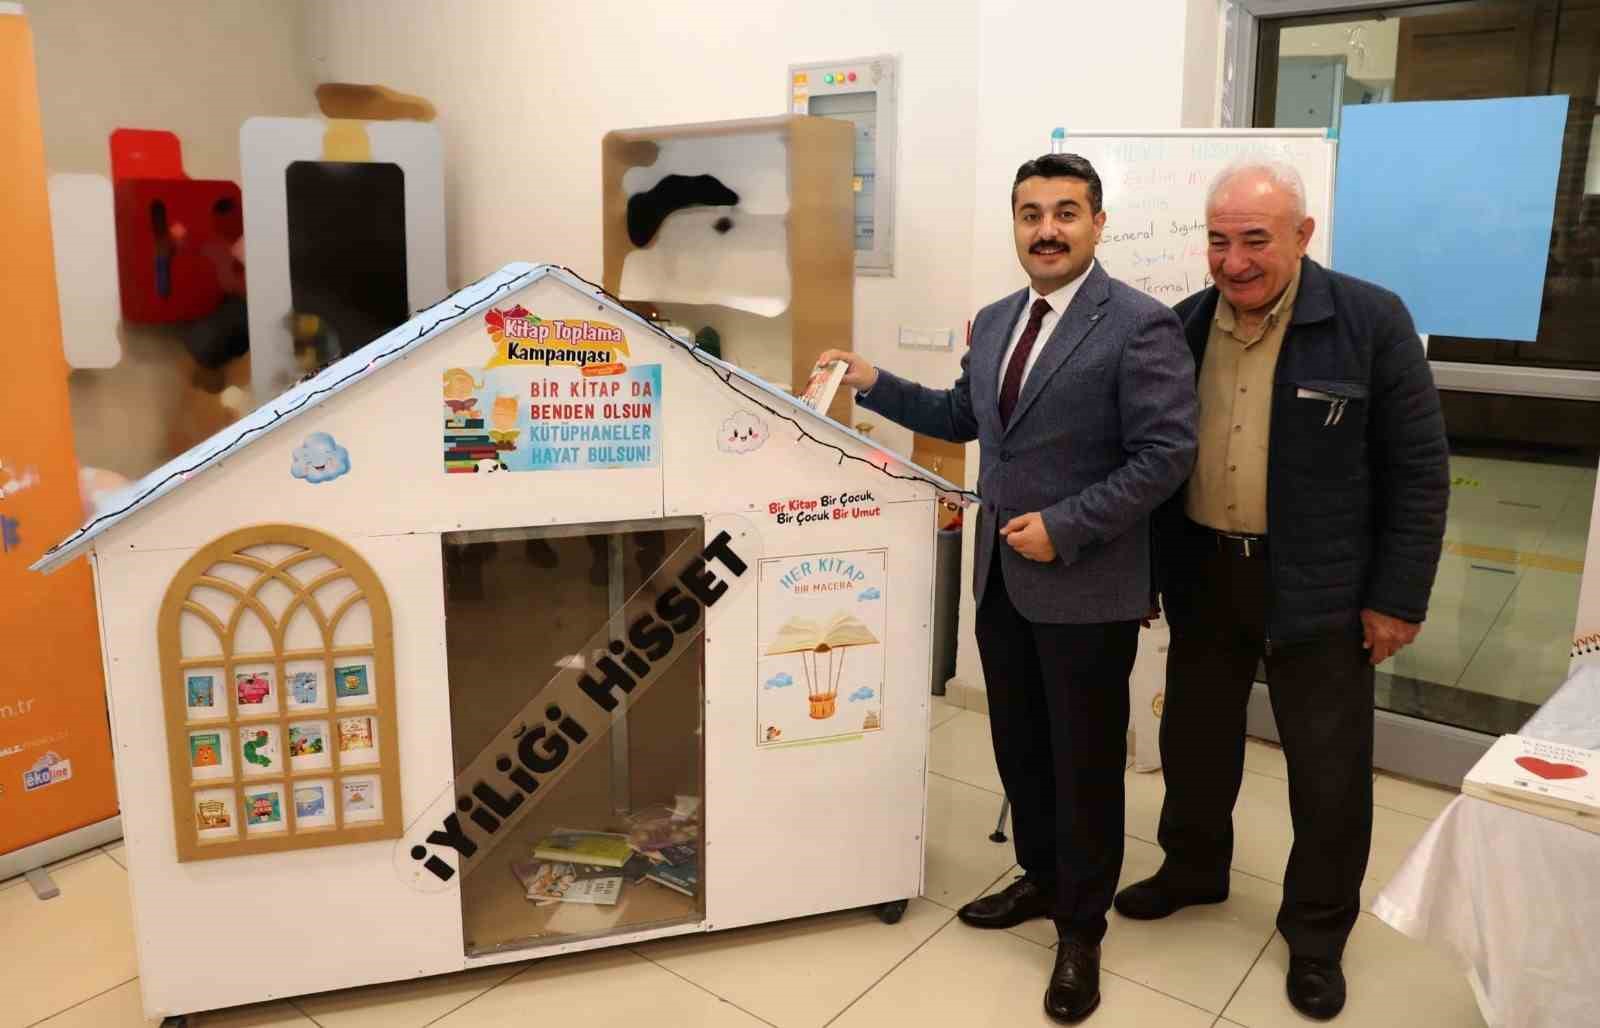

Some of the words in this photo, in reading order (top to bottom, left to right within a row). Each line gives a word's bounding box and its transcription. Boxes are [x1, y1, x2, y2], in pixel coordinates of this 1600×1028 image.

[504, 318, 549, 344] Kitap
[553, 320, 623, 344] Toplama
[508, 342, 610, 366] Kampanyası
[531, 378, 559, 397] BİR
[571, 378, 620, 397] KİTAP
[632, 381, 652, 397] DA
[531, 404, 594, 419] BENDEN
[603, 404, 652, 418] OLSUN
[530, 422, 651, 442] KÜTÜPHANELER
[532, 447, 579, 464] HAYAT
[588, 446, 651, 462] BULSUN!
[768, 502, 785, 514] Bir
[788, 499, 817, 511] Kitap
[820, 495, 837, 507] Bir
[839, 489, 875, 507] Çocuk,
[777, 512, 793, 525] Bir
[796, 510, 829, 526] Çocuk
[832, 508, 848, 520] Bir
[852, 507, 880, 519] Umut
[779, 561, 812, 589] HER
[818, 556, 865, 582] KİTAP
[813, 580, 853, 593] MACERA
